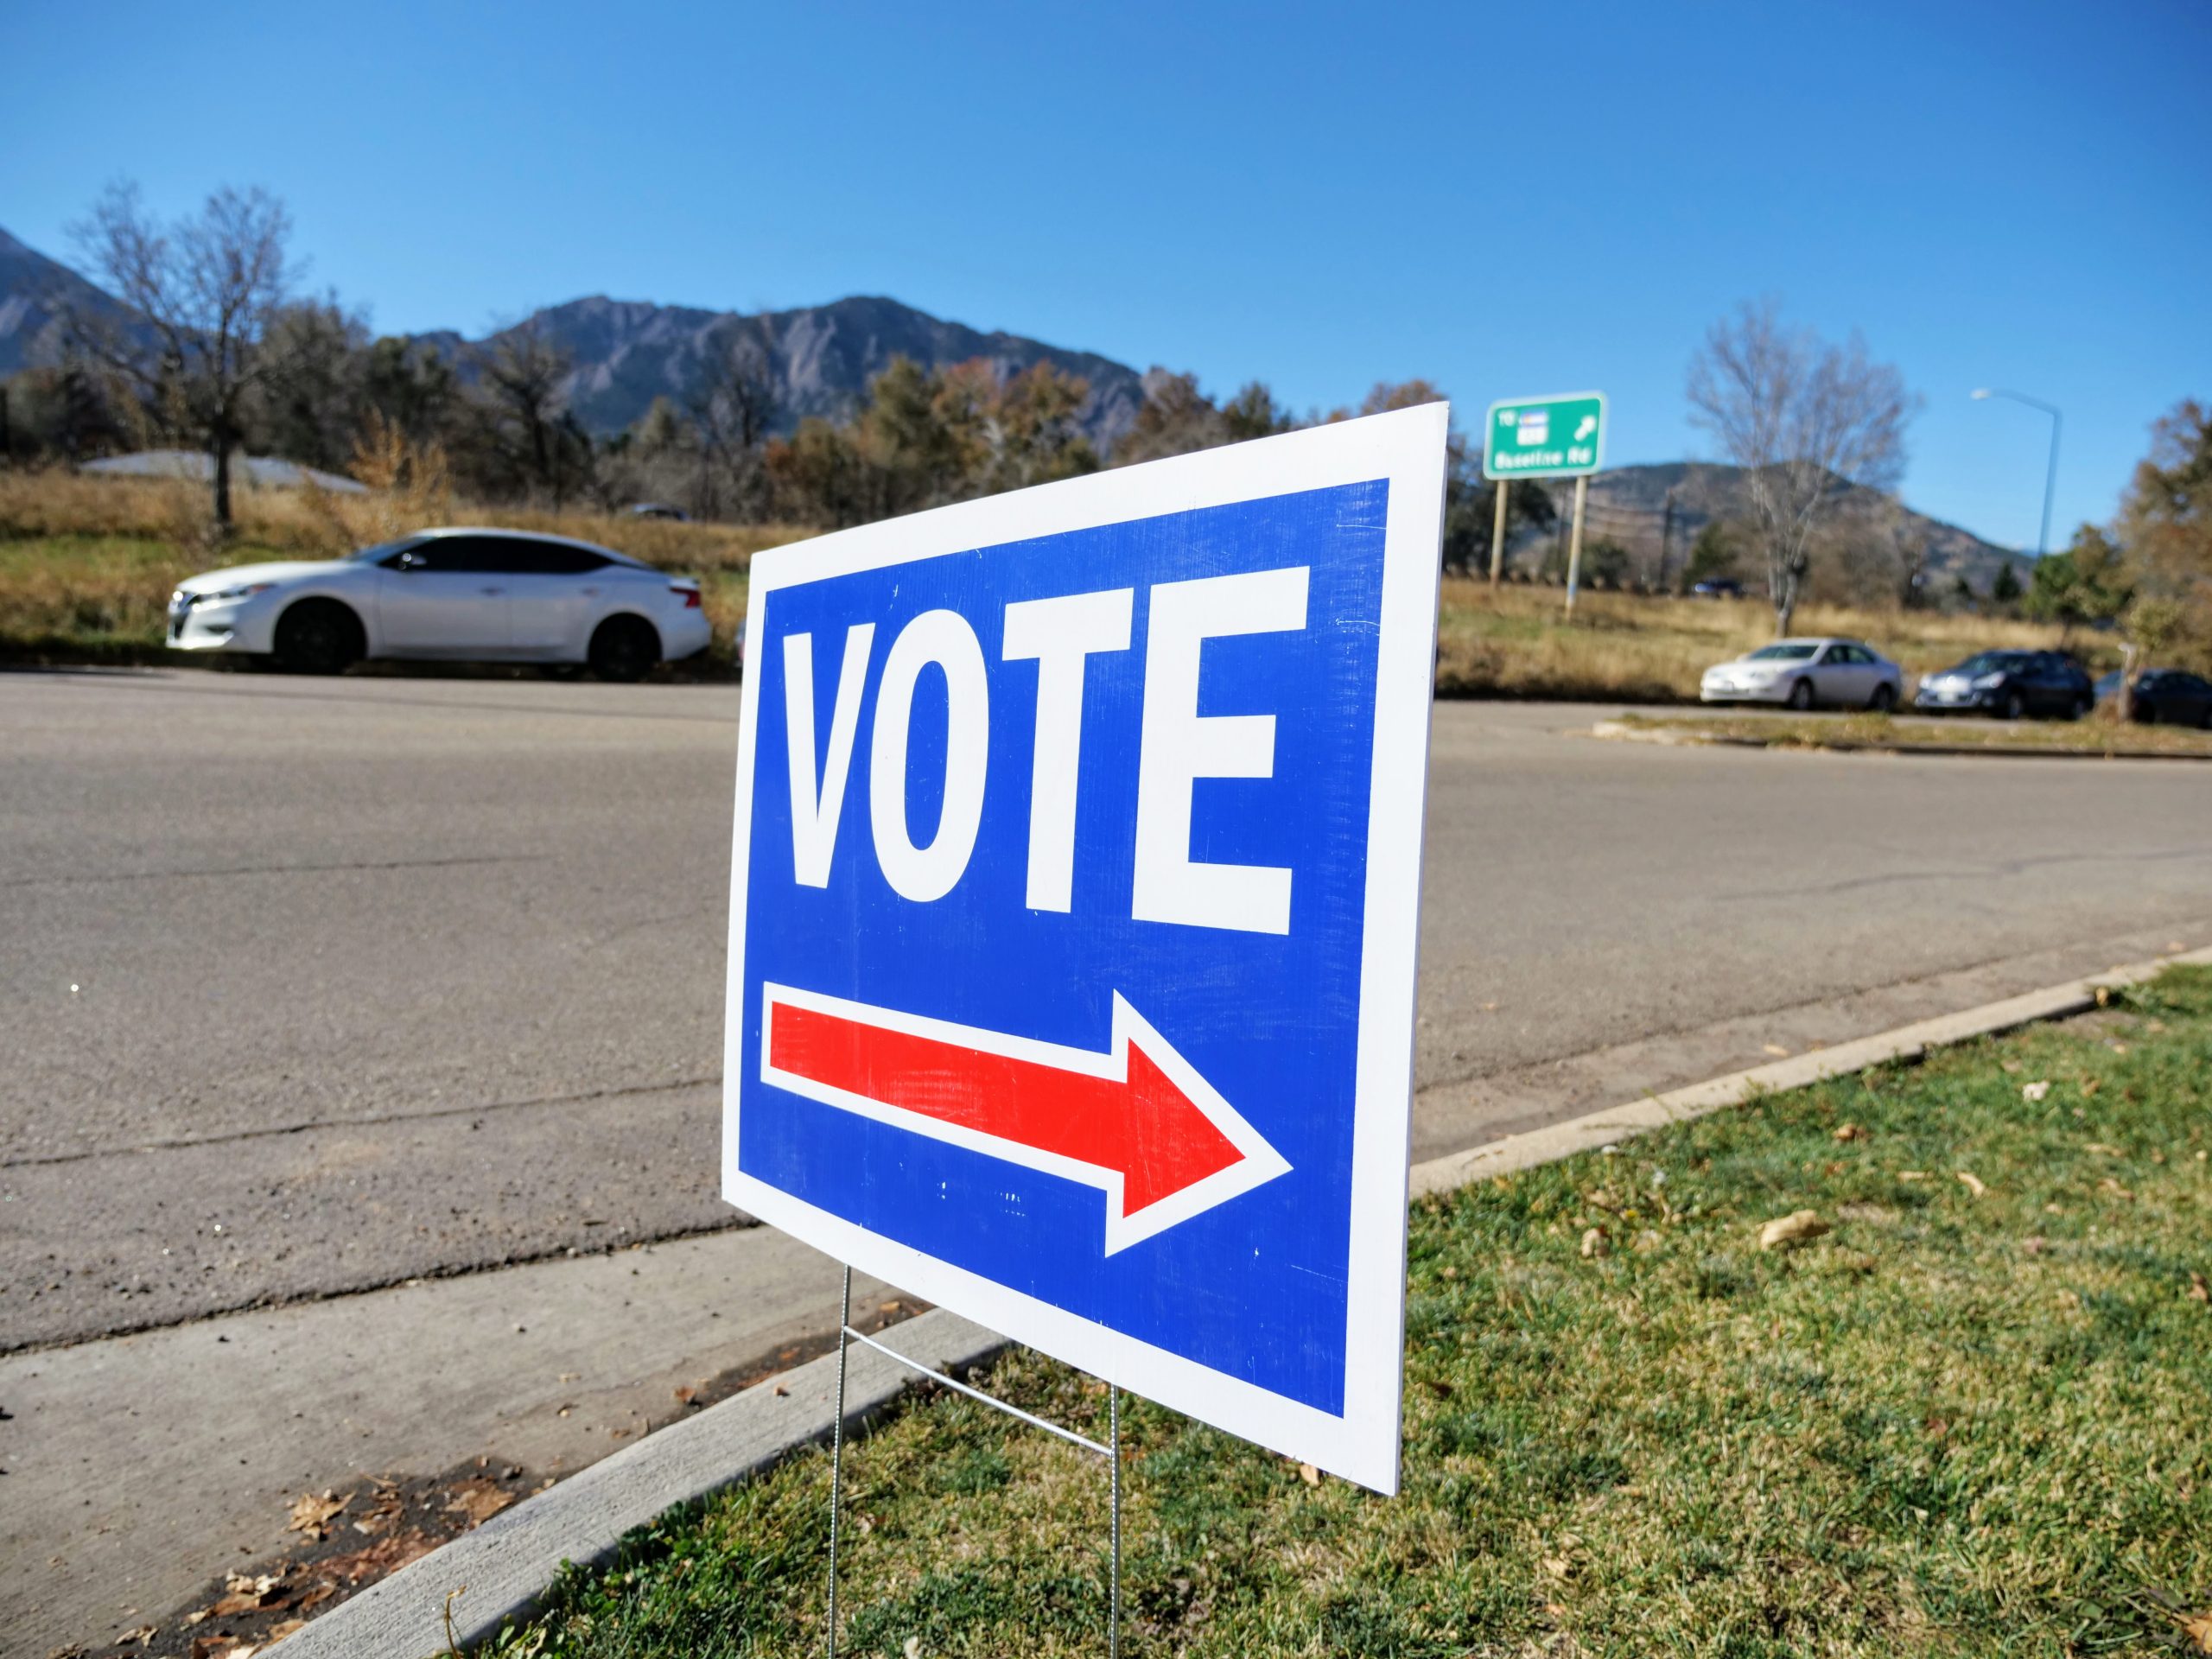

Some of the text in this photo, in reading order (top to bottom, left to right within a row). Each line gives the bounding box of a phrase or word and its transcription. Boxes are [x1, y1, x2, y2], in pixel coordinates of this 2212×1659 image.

[1495, 447, 1592, 469] Baseline Rd
[783, 566, 1311, 936] VOTE
